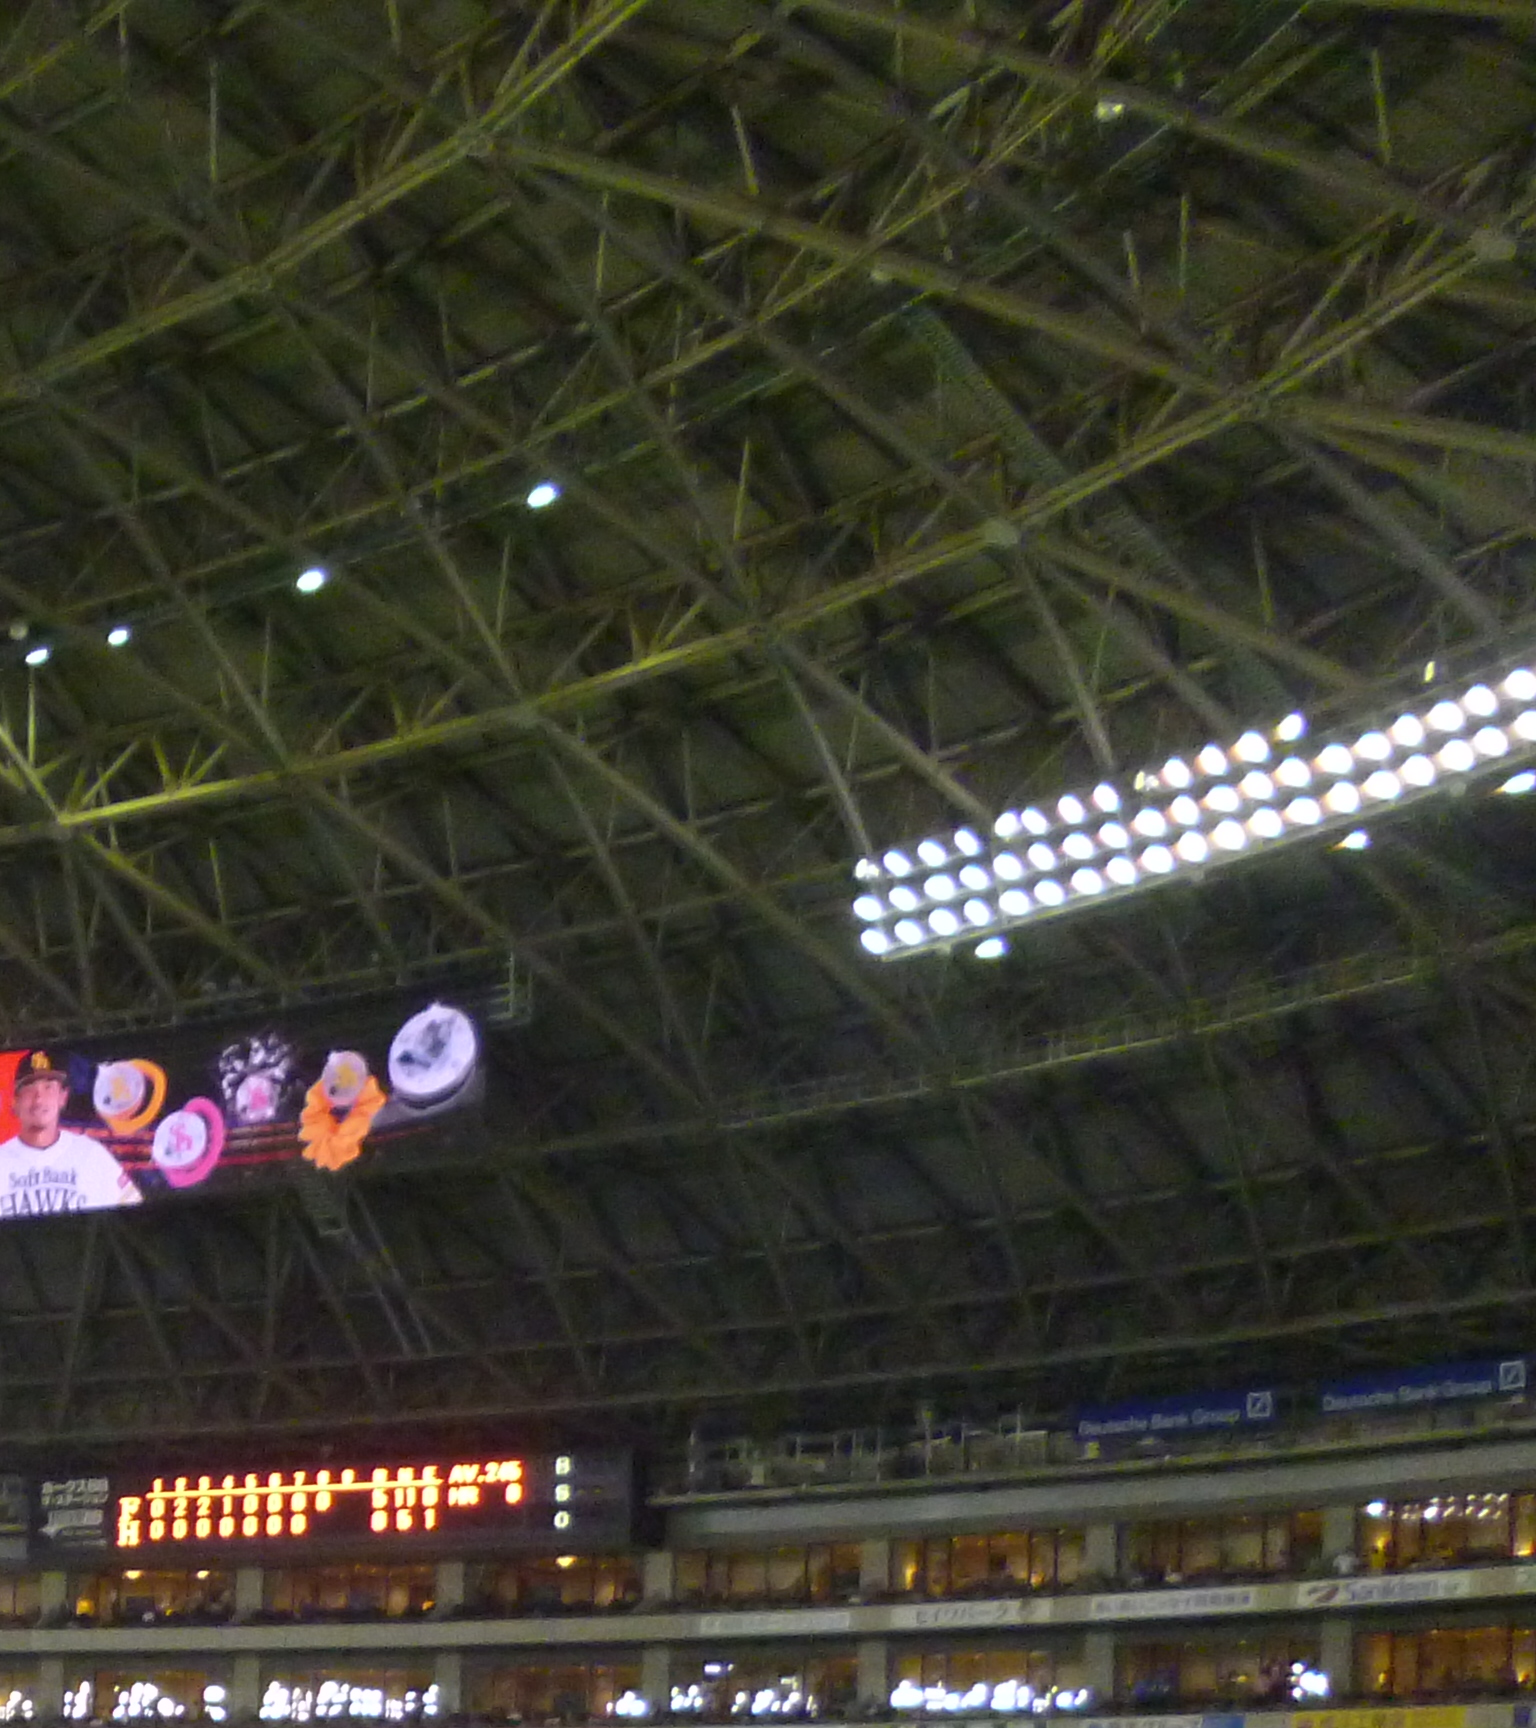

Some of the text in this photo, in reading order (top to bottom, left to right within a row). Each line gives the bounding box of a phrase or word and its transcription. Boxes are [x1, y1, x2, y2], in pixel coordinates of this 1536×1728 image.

[150, 1498, 165, 1518] 0
[174, 1497, 187, 1517] 2
[197, 1496, 211, 1516] 2
[395, 1487, 417, 1507] 11
[150, 1519, 164, 1540] 0
[172, 1518, 187, 1540] 0
[196, 1517, 211, 1538] 0
[219, 1516, 235, 1537] 0
[243, 1515, 258, 1536] 0
[266, 1514, 282, 1536] 0
[290, 1513, 307, 1535] 0
